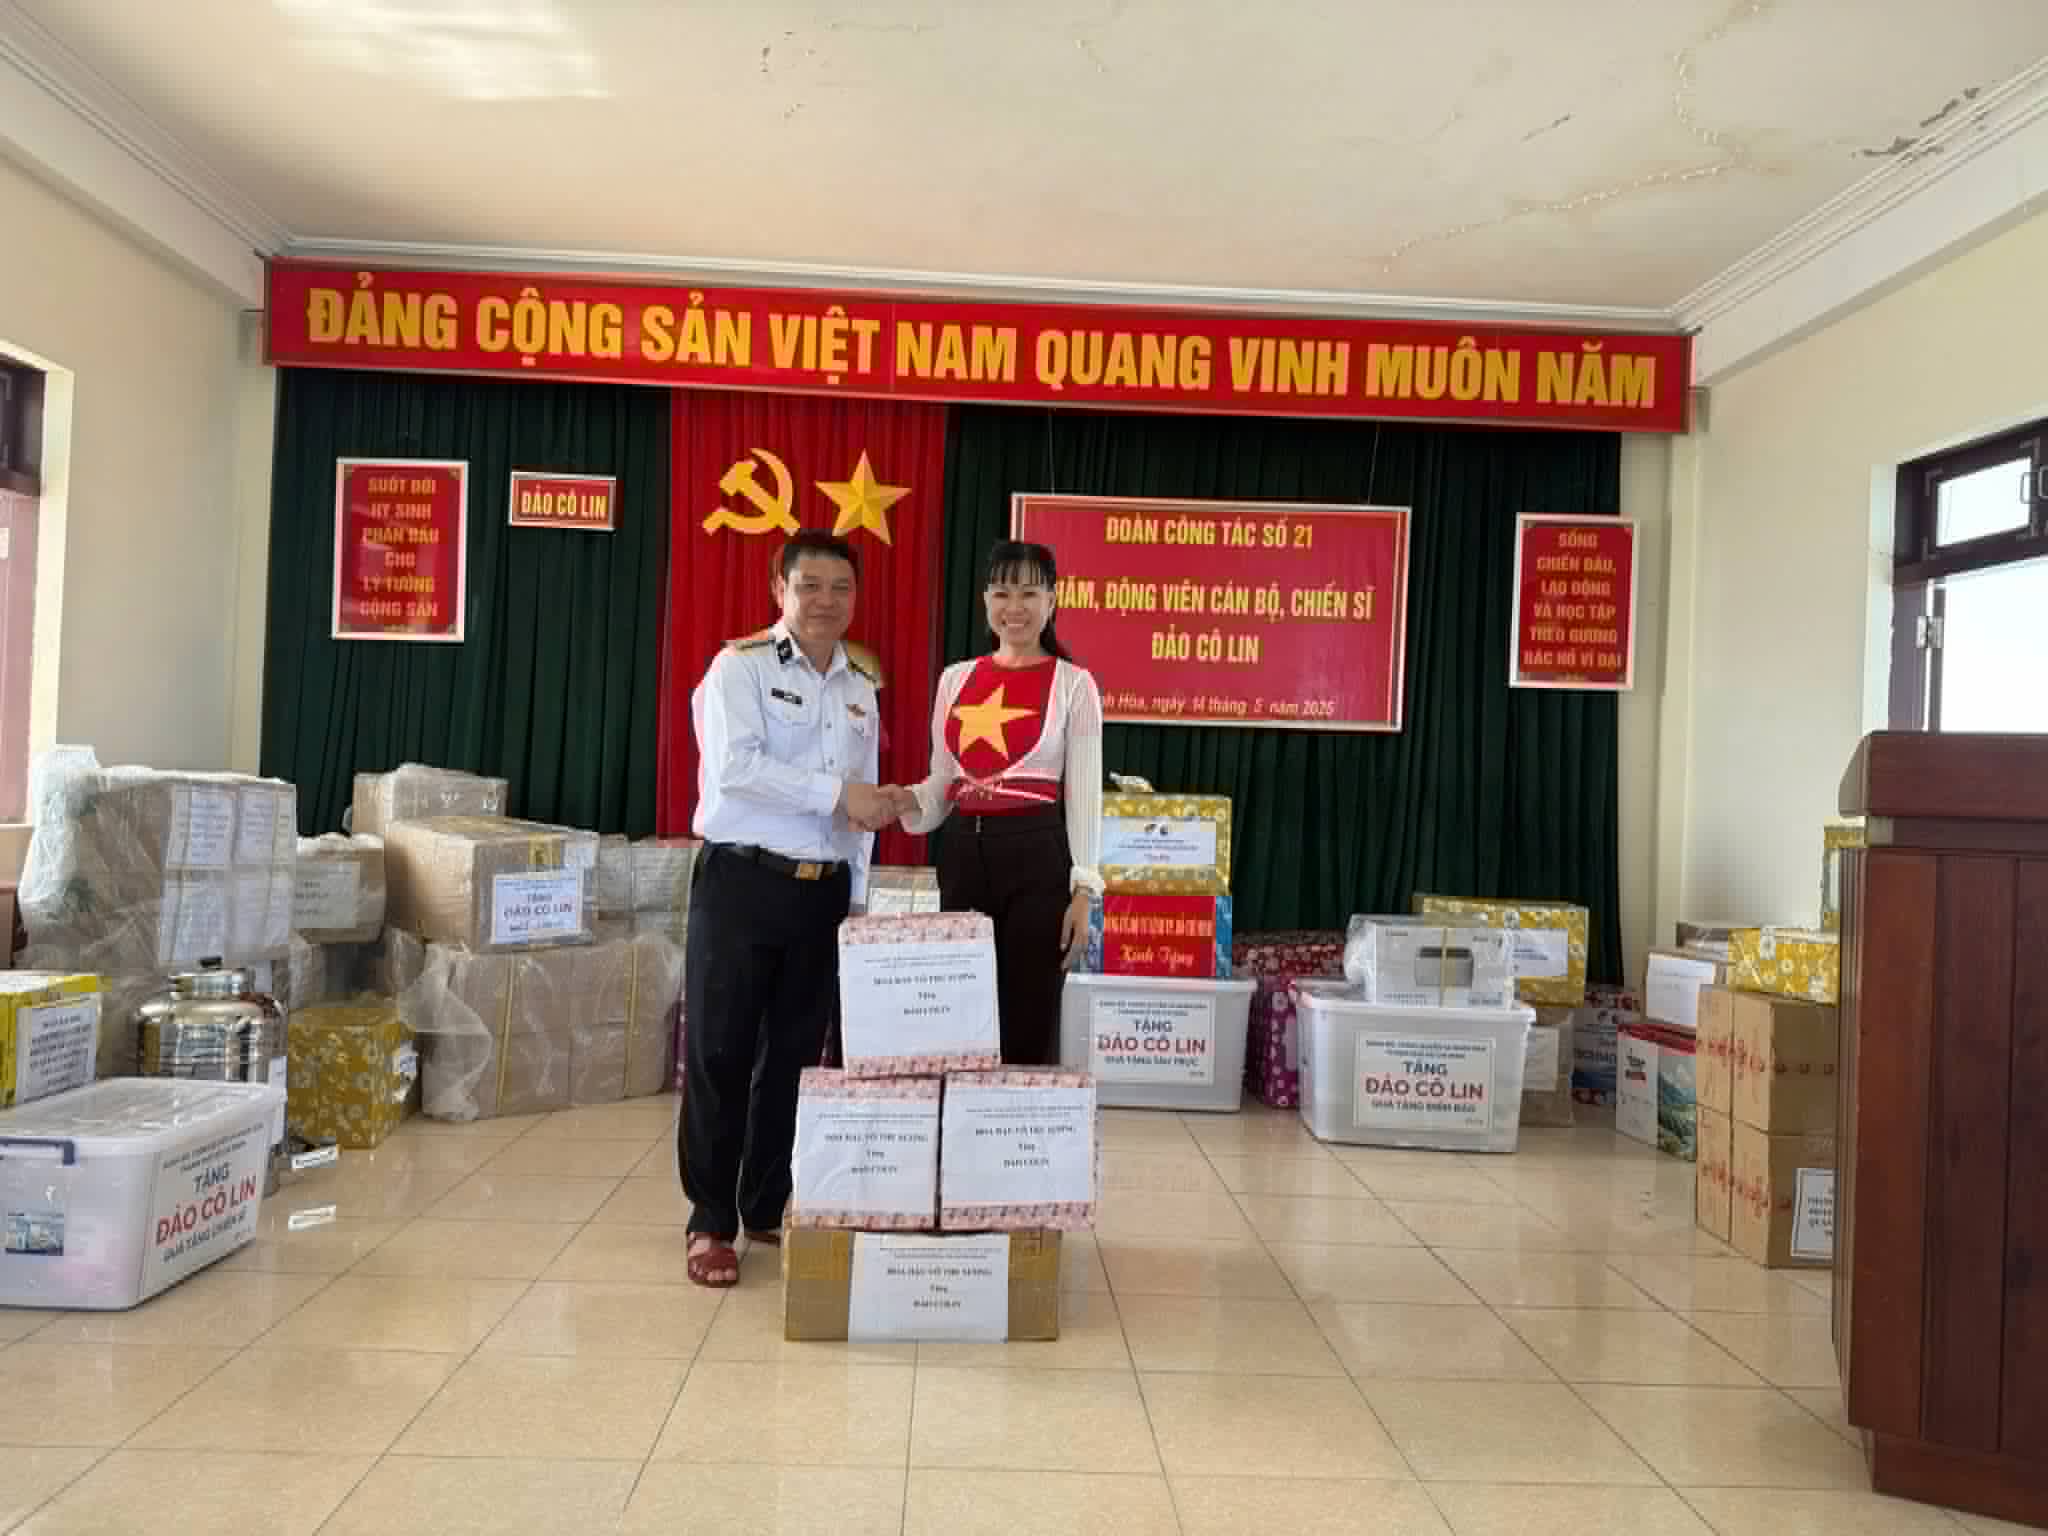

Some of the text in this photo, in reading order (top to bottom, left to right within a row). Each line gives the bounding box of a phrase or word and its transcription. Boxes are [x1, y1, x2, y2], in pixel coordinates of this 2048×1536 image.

[307, 272, 1657, 409] ĐẢNG CỘNG SẢN VIỆT NAM QUANG VINH MUÔN NĂM
[521, 482, 607, 520] ĐẢO CÔ LIN
[1105, 513, 1313, 549] ĐOÀN CÔNG TÁC SỐ 21
[1104, 577, 1158, 617] ĐỘNG
[1163, 579, 1206, 614] VIÊN
[1210, 580, 1250, 615] CÁN
[1254, 583, 1285, 625] BỘ,
[1290, 580, 1348, 618] CHIẾN
[1353, 585, 1376, 621] SĨ
[1540, 580, 1568, 596] LAO
[1151, 624, 1260, 664] ĐẢO CÔ LIN
[1151, 690, 1186, 714] ngày
[1208, 691, 1248, 716] tháng
[1097, 1033, 1206, 1054] ĐẢO CÔ LIN
[1134, 1019, 1173, 1036] TẶNG
[1402, 1060, 1448, 1077] TẶNG
[1365, 1072, 1484, 1100] ĐẢO CÔ LIN
[193, 1161, 231, 1193] TẶNG
[156, 1202, 197, 1247] ĐẢO
[201, 1184, 226, 1221] CÔ
[230, 1174, 257, 1208] LIN
